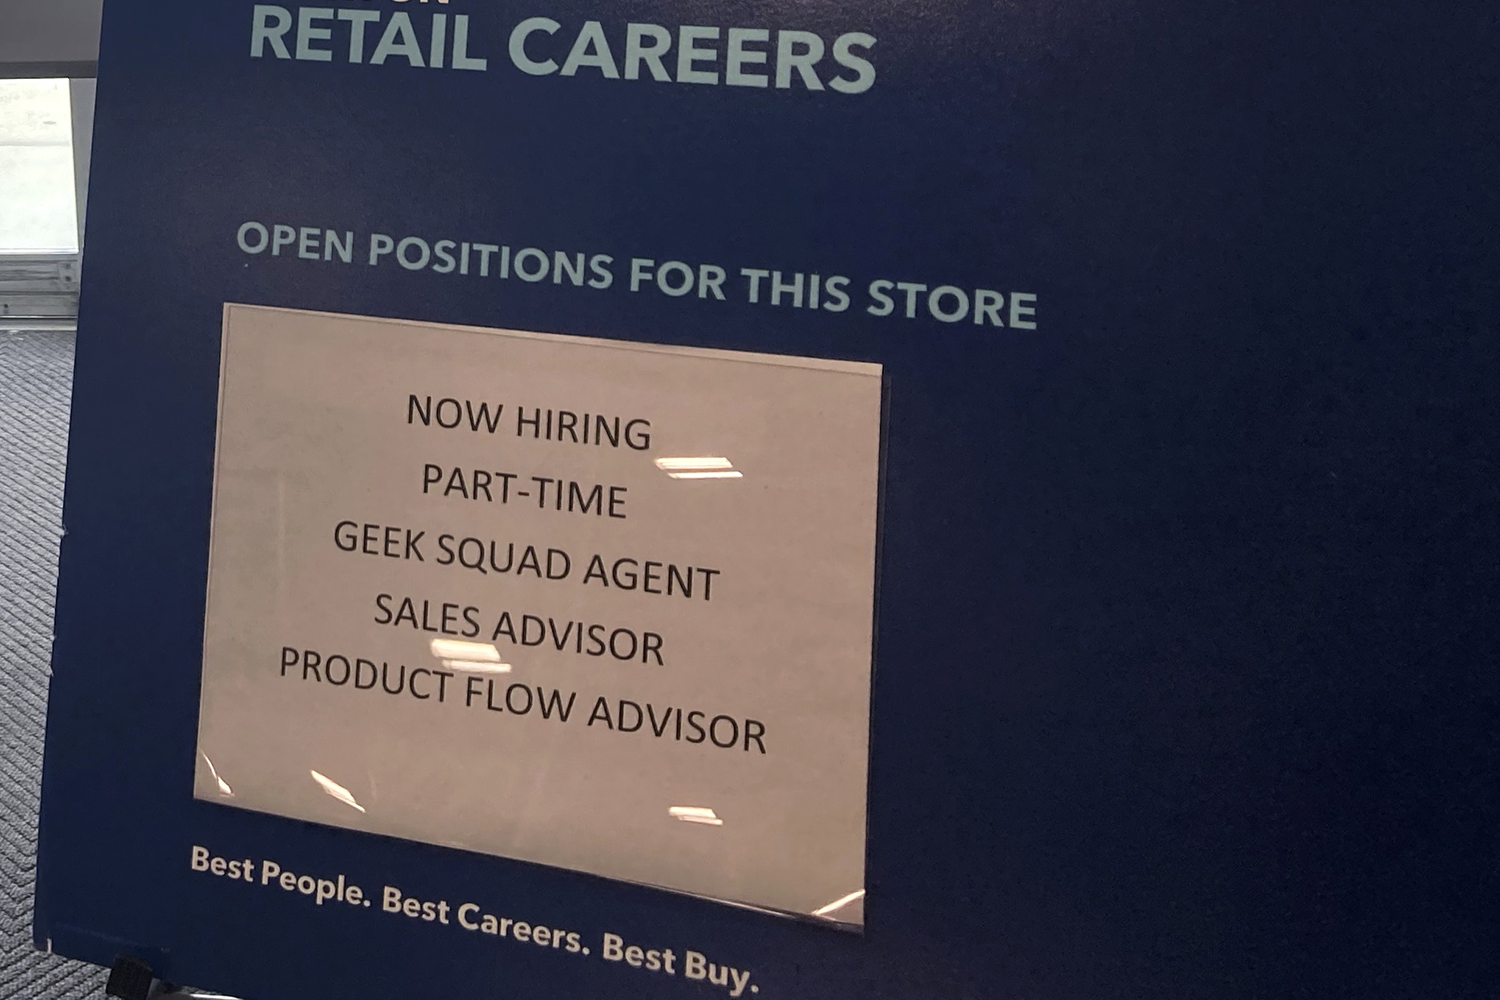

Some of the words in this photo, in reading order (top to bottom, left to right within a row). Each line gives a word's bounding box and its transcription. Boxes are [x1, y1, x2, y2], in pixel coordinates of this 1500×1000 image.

[250, 4, 488, 72] RETAIL
[508, 16, 878, 94] CAREERS
[237, 221, 354, 263] OPEN
[369, 233, 614, 290] POSITIONS
[629, 257, 727, 301] FOR
[740, 267, 851, 312] THIS
[866, 279, 1039, 332] STORE
[407, 394, 504, 434] NOW
[516, 405, 651, 451] HIRING
[422, 463, 628, 520] PART-TIME
[334, 520, 426, 560] GEEK
[436, 533, 571, 581] SQUAD
[582, 553, 721, 602] AGENT
[374, 593, 481, 639] SALES
[490, 611, 664, 667] ADVISOR
[280, 646, 455, 703] PRODUCT
[465, 675, 577, 723] FLOW
[586, 696, 767, 755] ADVISOR
[191, 845, 255, 883] Best
[261, 859, 371, 908] People.
[382, 885, 451, 925] Best
[457, 902, 591, 956] Careers.
[602, 932, 677, 975] Best
[684, 950, 759, 997] Buy.
